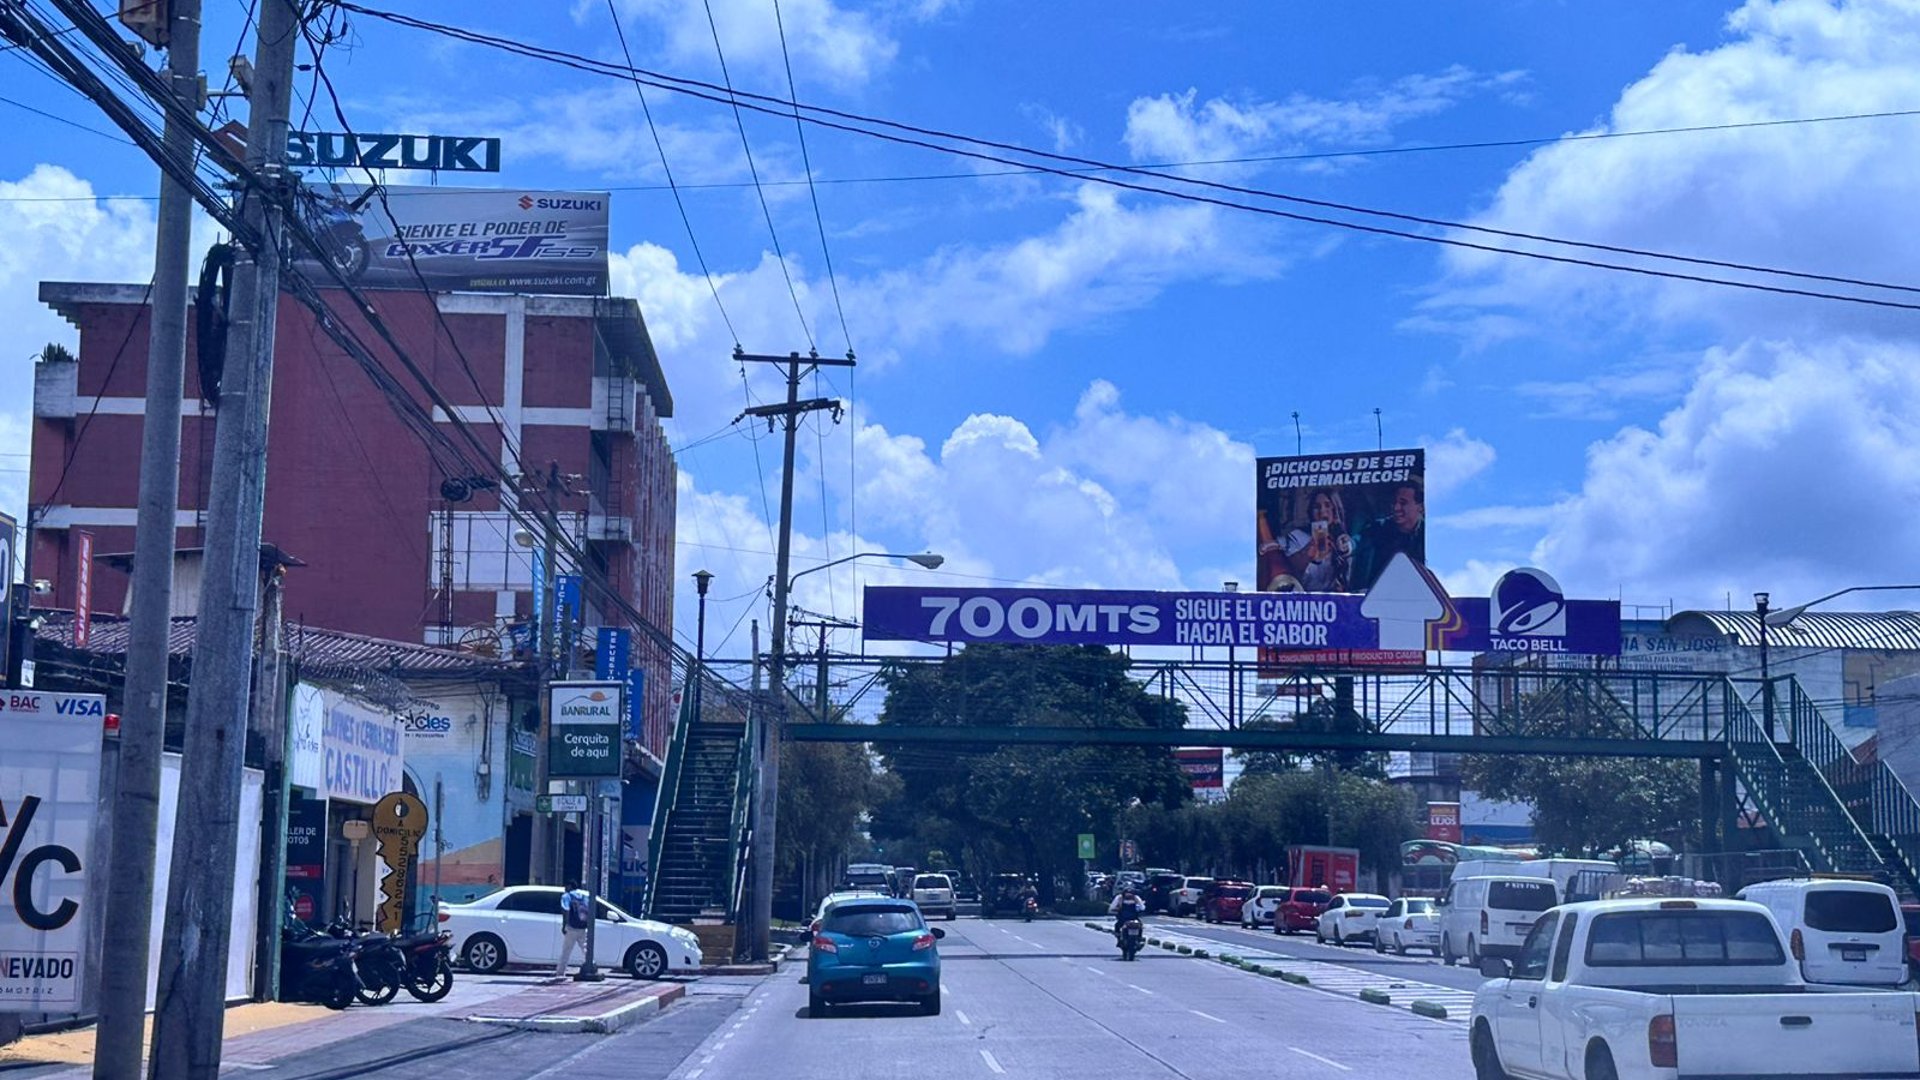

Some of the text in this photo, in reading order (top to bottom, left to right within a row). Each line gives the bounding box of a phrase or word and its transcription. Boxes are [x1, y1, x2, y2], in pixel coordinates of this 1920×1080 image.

[288, 131, 500, 172] SUZUKI
[537, 198, 601, 212] SUZUKI
[394, 220, 567, 238] SIENTE EL PODER DE
[1265, 454, 1416, 477] ¡DICHOSOS DE SER
[1267, 469, 1410, 489] GUATEMALTECOS!
[921, 596, 1160, 638] 700MTS
[1176, 599, 1336, 623] SIGUE EL CAMINO
[1176, 622, 1327, 646] HACIA EL SABOR
[1491, 638, 1566, 652] TACO BELL
[1647, 637, 1678, 651] SAN
[1352, 651, 1393, 661] PRODUCTO
[1396, 650, 1424, 660] CAUSA
[11, 695, 102, 716] BAC VISA
[561, 706, 611, 716] BANRURAL
[564, 733, 609, 746] Cerquita
[571, 749, 585, 757] de
[325, 749, 388, 800] CASTILLO
[1431, 815, 1457, 825] LEJOS
[306, 828, 316, 836] DE
